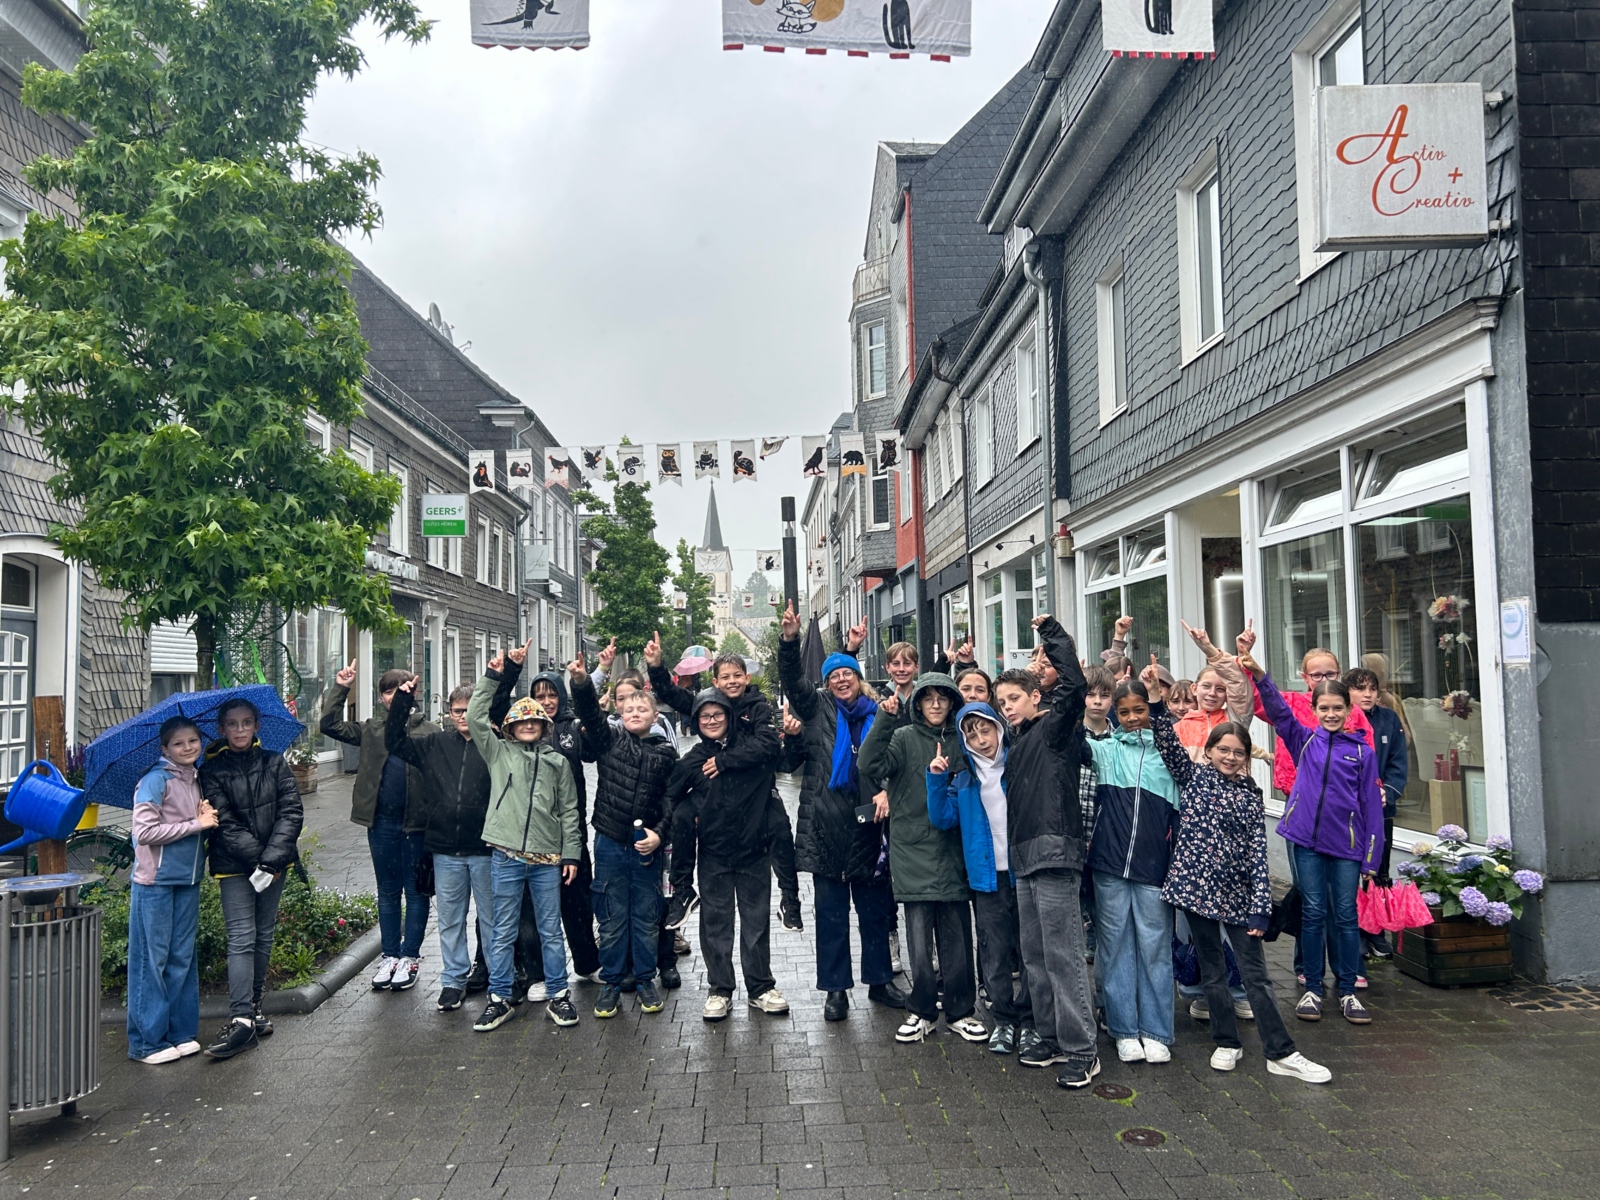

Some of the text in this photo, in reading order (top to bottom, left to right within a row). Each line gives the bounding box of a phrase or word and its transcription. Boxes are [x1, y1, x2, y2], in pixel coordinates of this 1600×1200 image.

[1336, 104, 1447, 165] Activ
[1372, 155, 1474, 216] Creativ
[1448, 167, 1463, 184] +
[426, 507, 457, 515] GEERS
